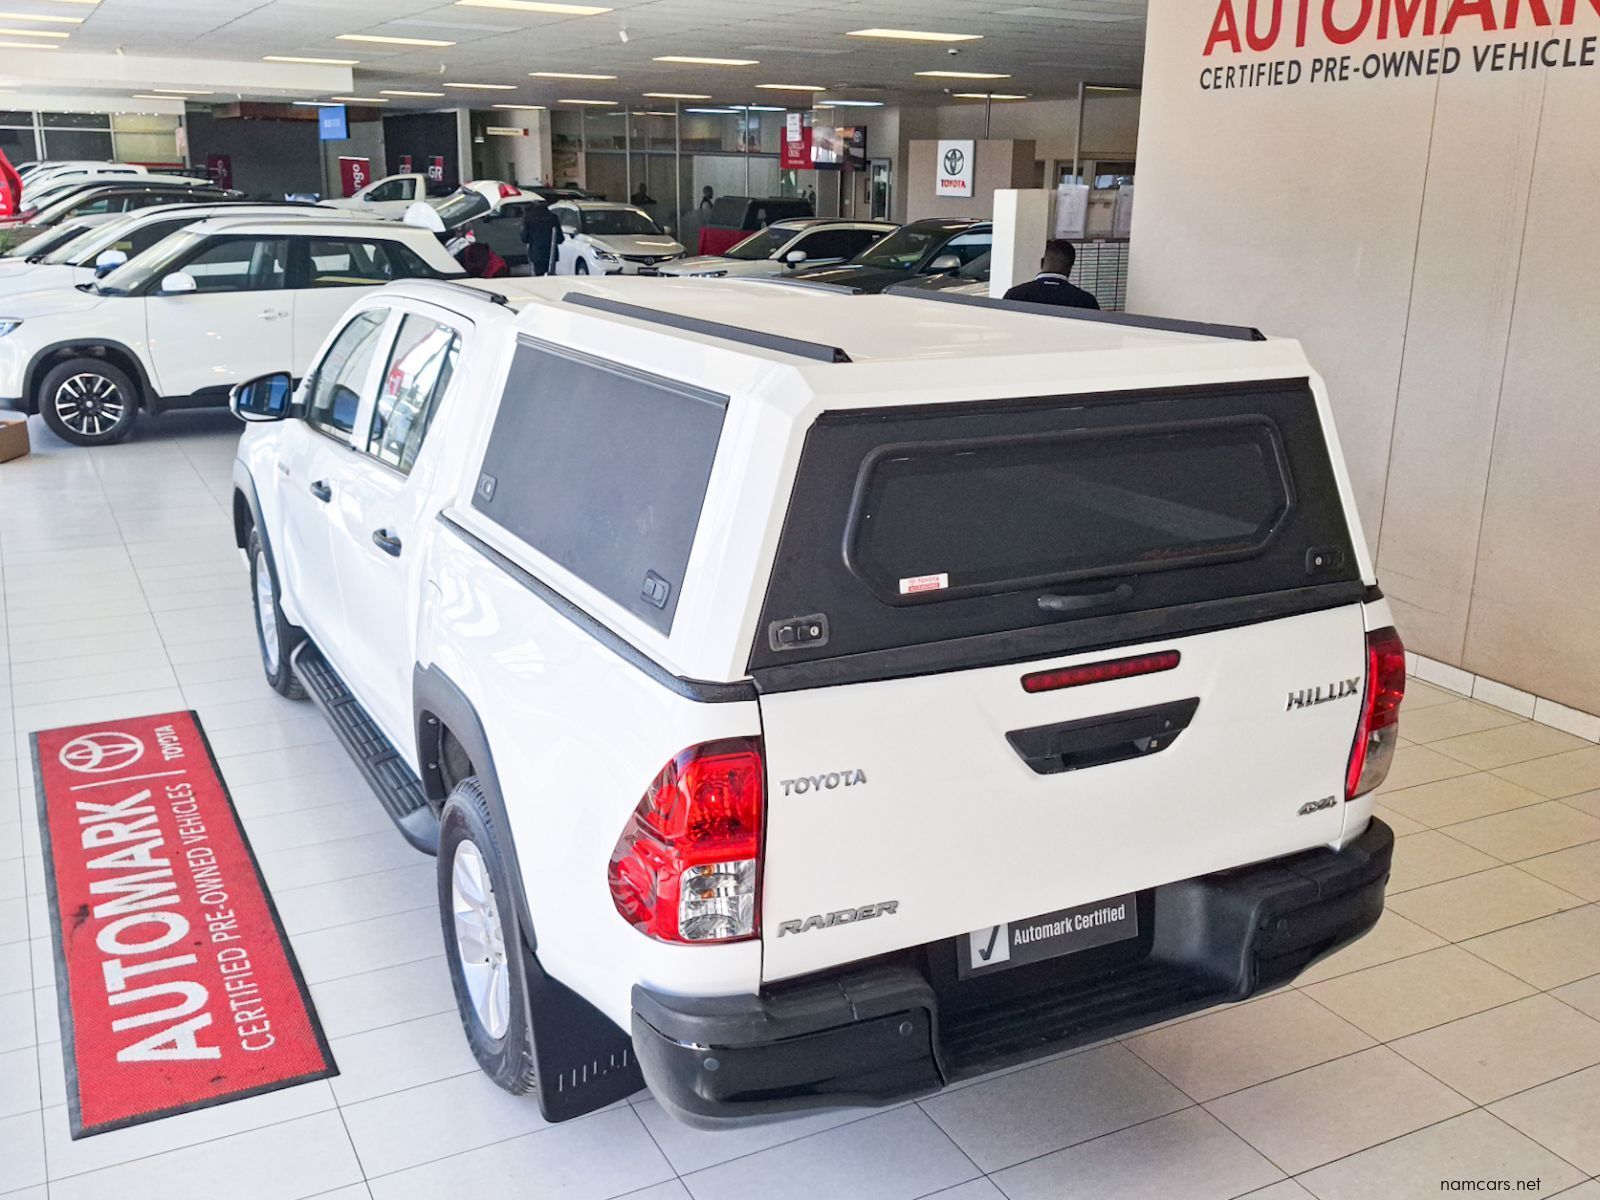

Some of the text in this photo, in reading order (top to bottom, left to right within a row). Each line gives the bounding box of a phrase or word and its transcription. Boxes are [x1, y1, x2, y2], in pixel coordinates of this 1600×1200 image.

[1203, 0, 1600, 56] AUOMA
[1200, 36, 1597, 90] CERTIFIED PRE-OWNED VEHICLE
[429, 165, 443, 180] GR
[941, 179, 966, 188] TOYOTA
[1285, 676, 1360, 711] HILUX
[154, 725, 185, 761] TOYOTA
[780, 769, 867, 796] TOYOTA
[75, 789, 222, 1062] AUTOMARK
[165, 783, 276, 1051] CERTIFIED PRE-OWNED VEHICLES
[777, 900, 899, 938] RAIDER
[1014, 904, 1126, 946] Automark Certified
